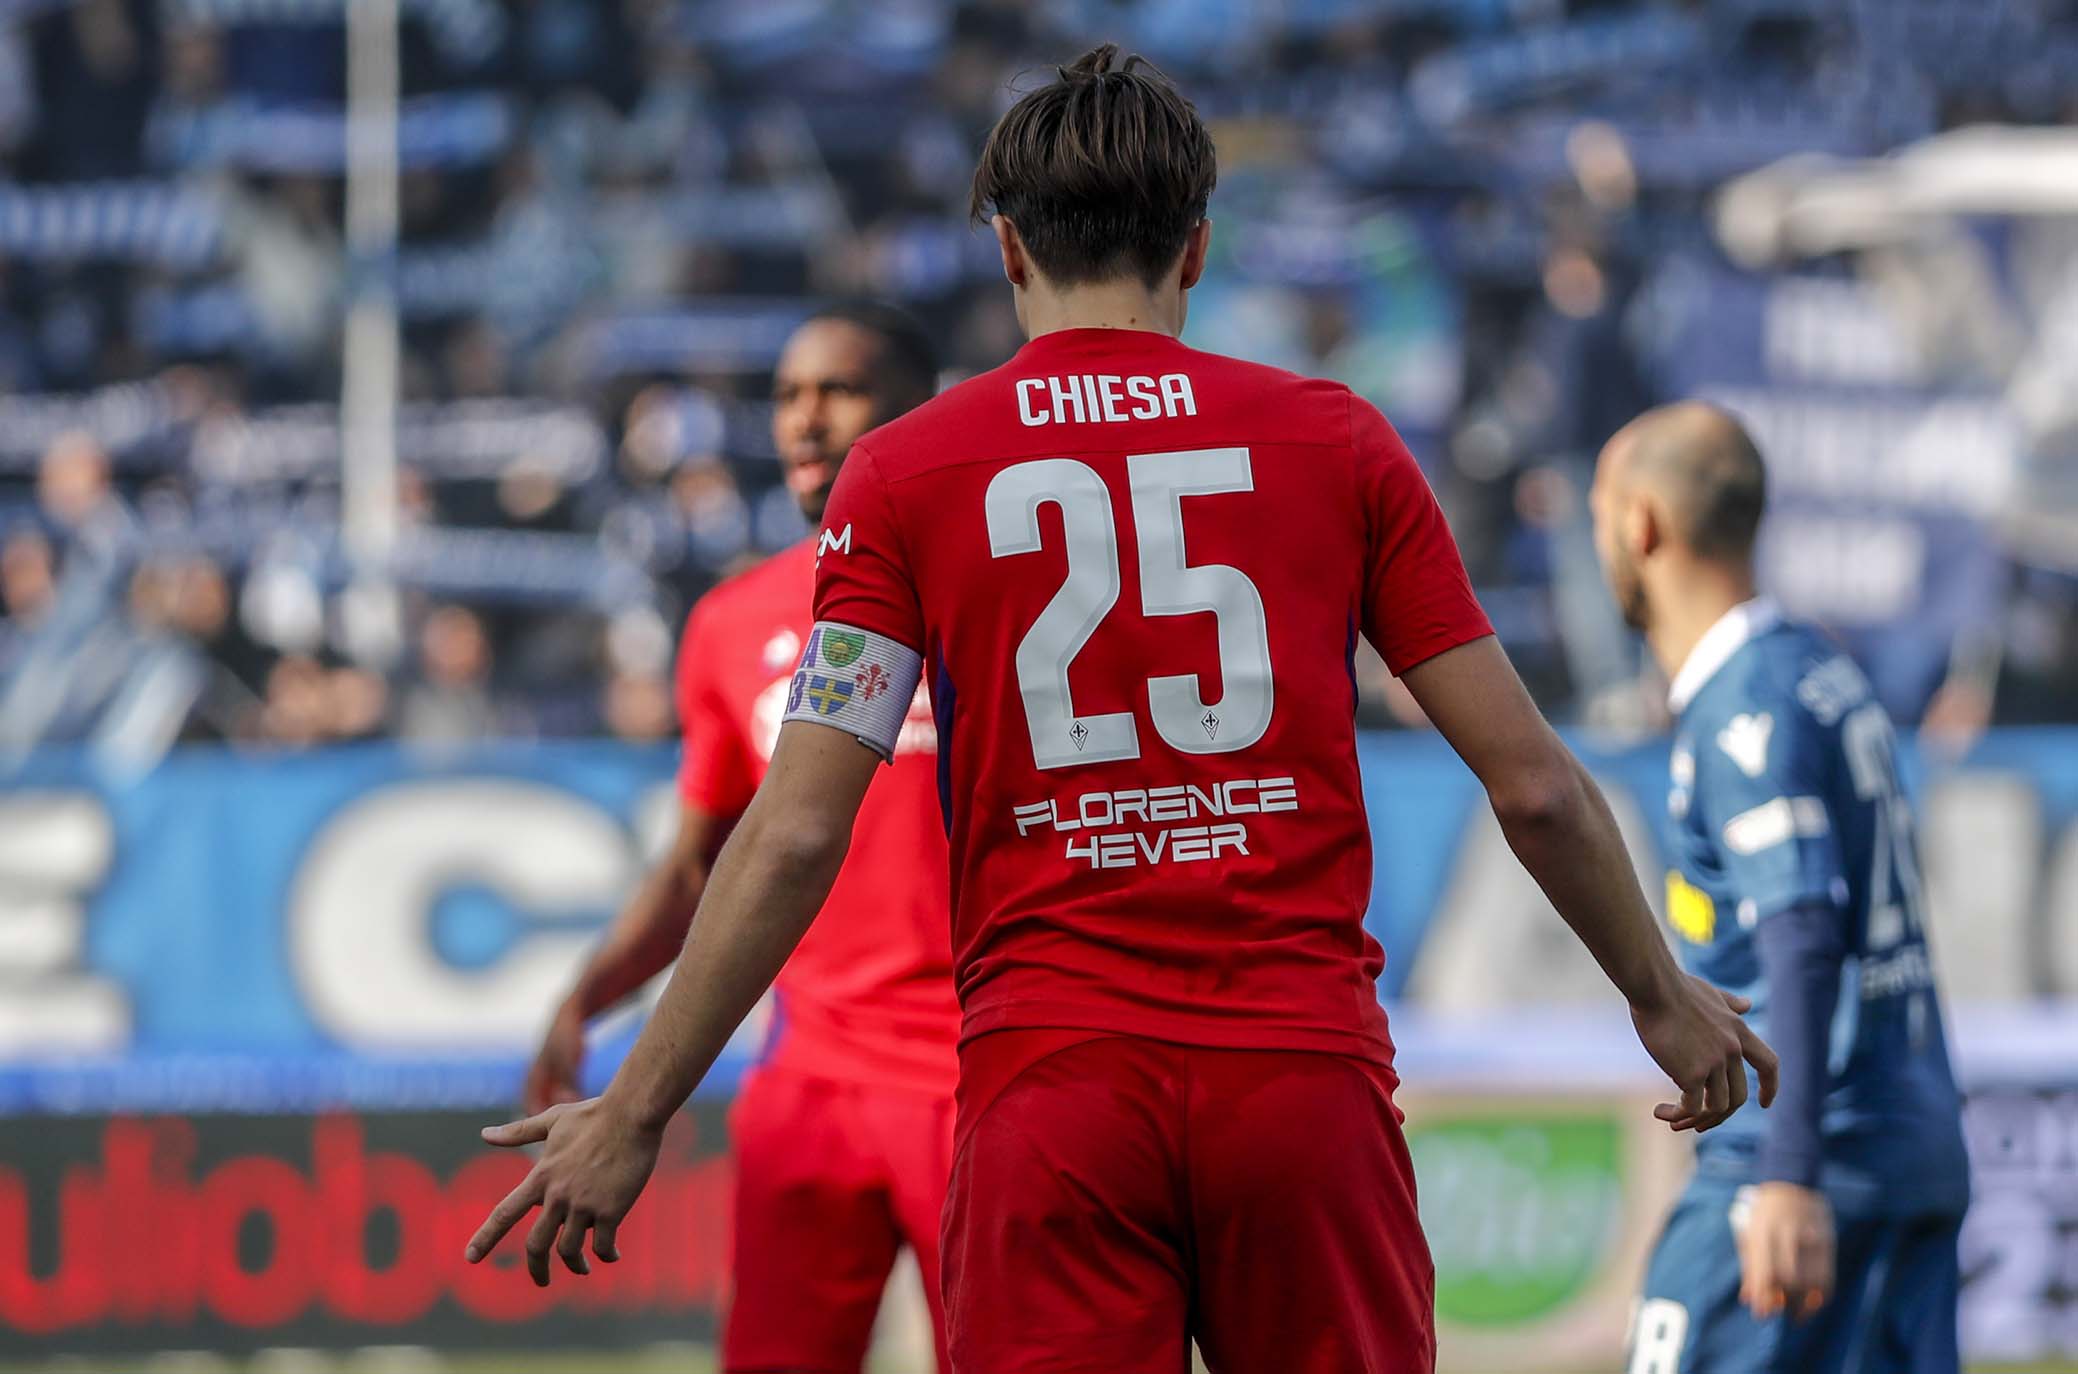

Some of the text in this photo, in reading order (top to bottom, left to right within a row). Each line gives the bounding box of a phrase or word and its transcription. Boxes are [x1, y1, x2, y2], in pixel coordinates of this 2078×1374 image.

[1015, 373, 1197, 426] CHIESA
[817, 523, 852, 557] M
[985, 447, 1274, 770] 25
[1013, 777, 1298, 837] FLORENCE
[1065, 823, 1250, 869] 4EVER
